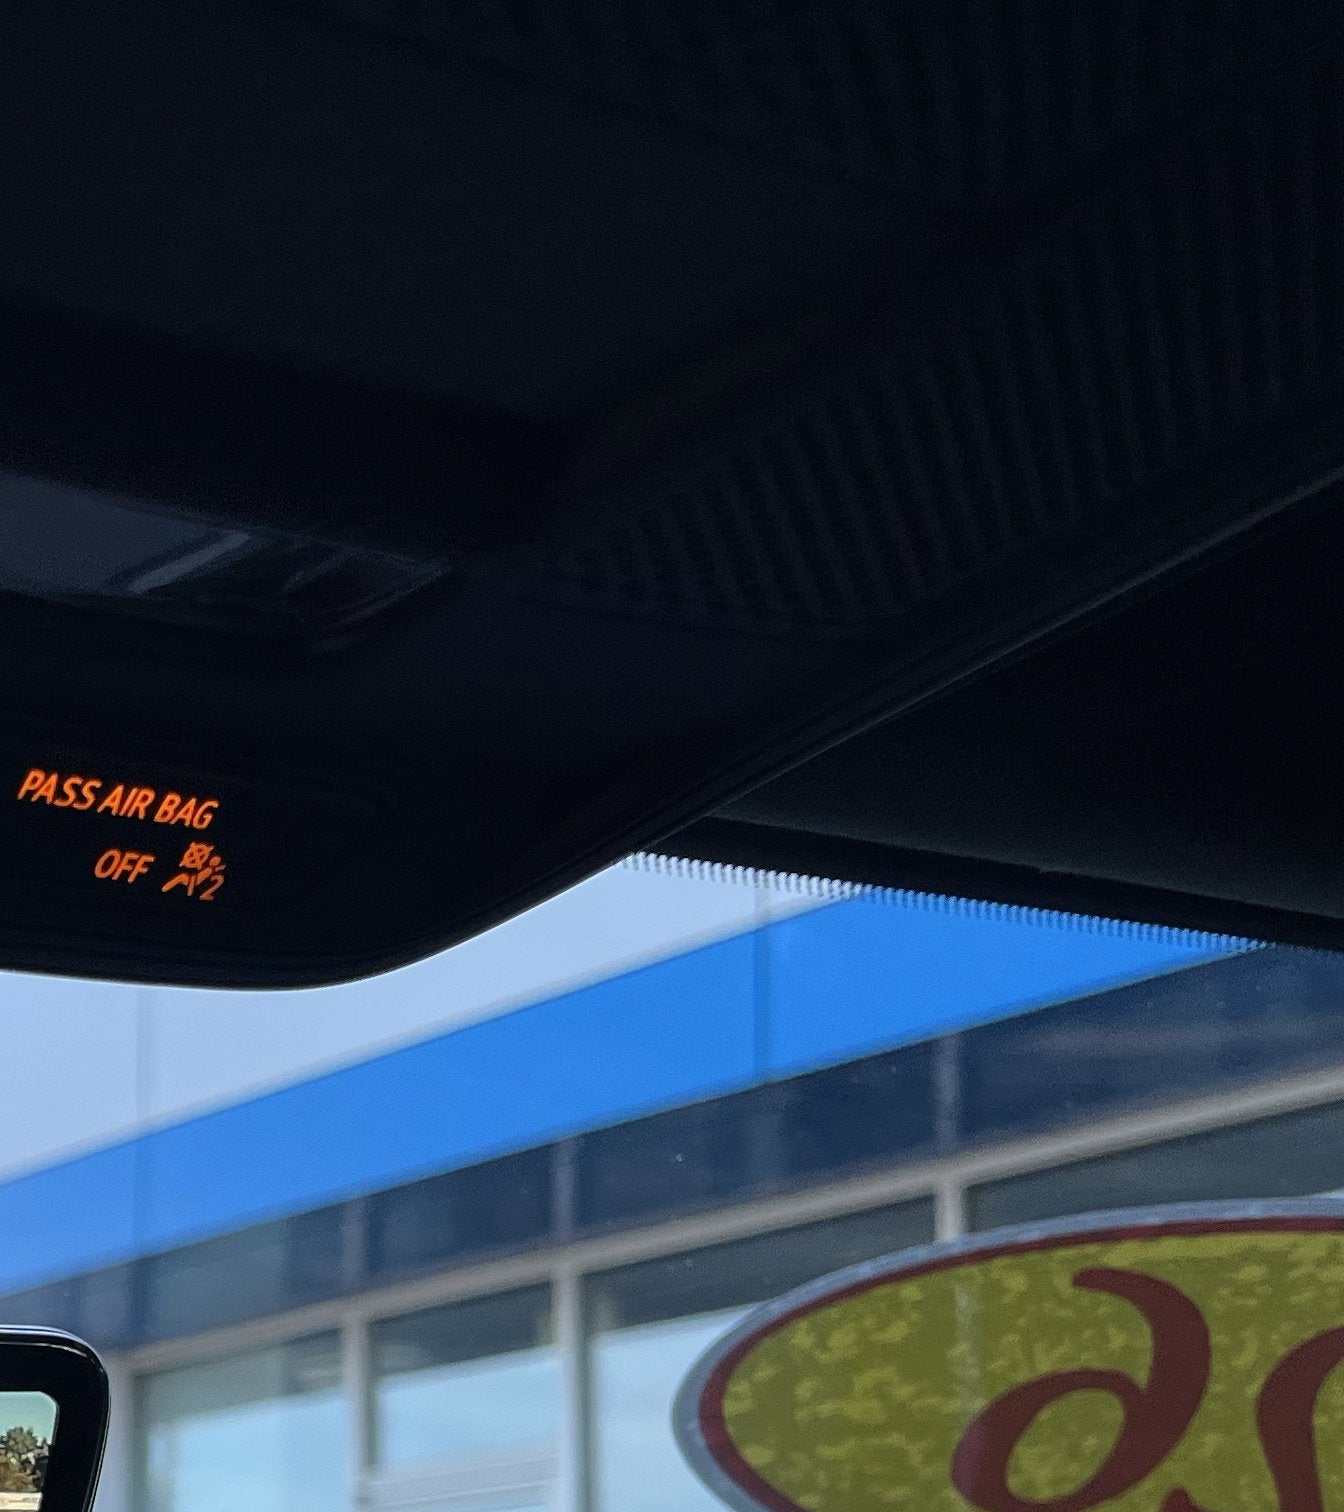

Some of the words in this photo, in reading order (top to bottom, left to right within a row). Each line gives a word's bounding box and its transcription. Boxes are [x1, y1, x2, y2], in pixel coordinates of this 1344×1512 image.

[17, 768, 103, 811] PASS
[97, 784, 157, 820] AIR
[153, 792, 220, 830] BAG
[94, 848, 156, 884] OFF
[198, 874, 225, 901] 2
